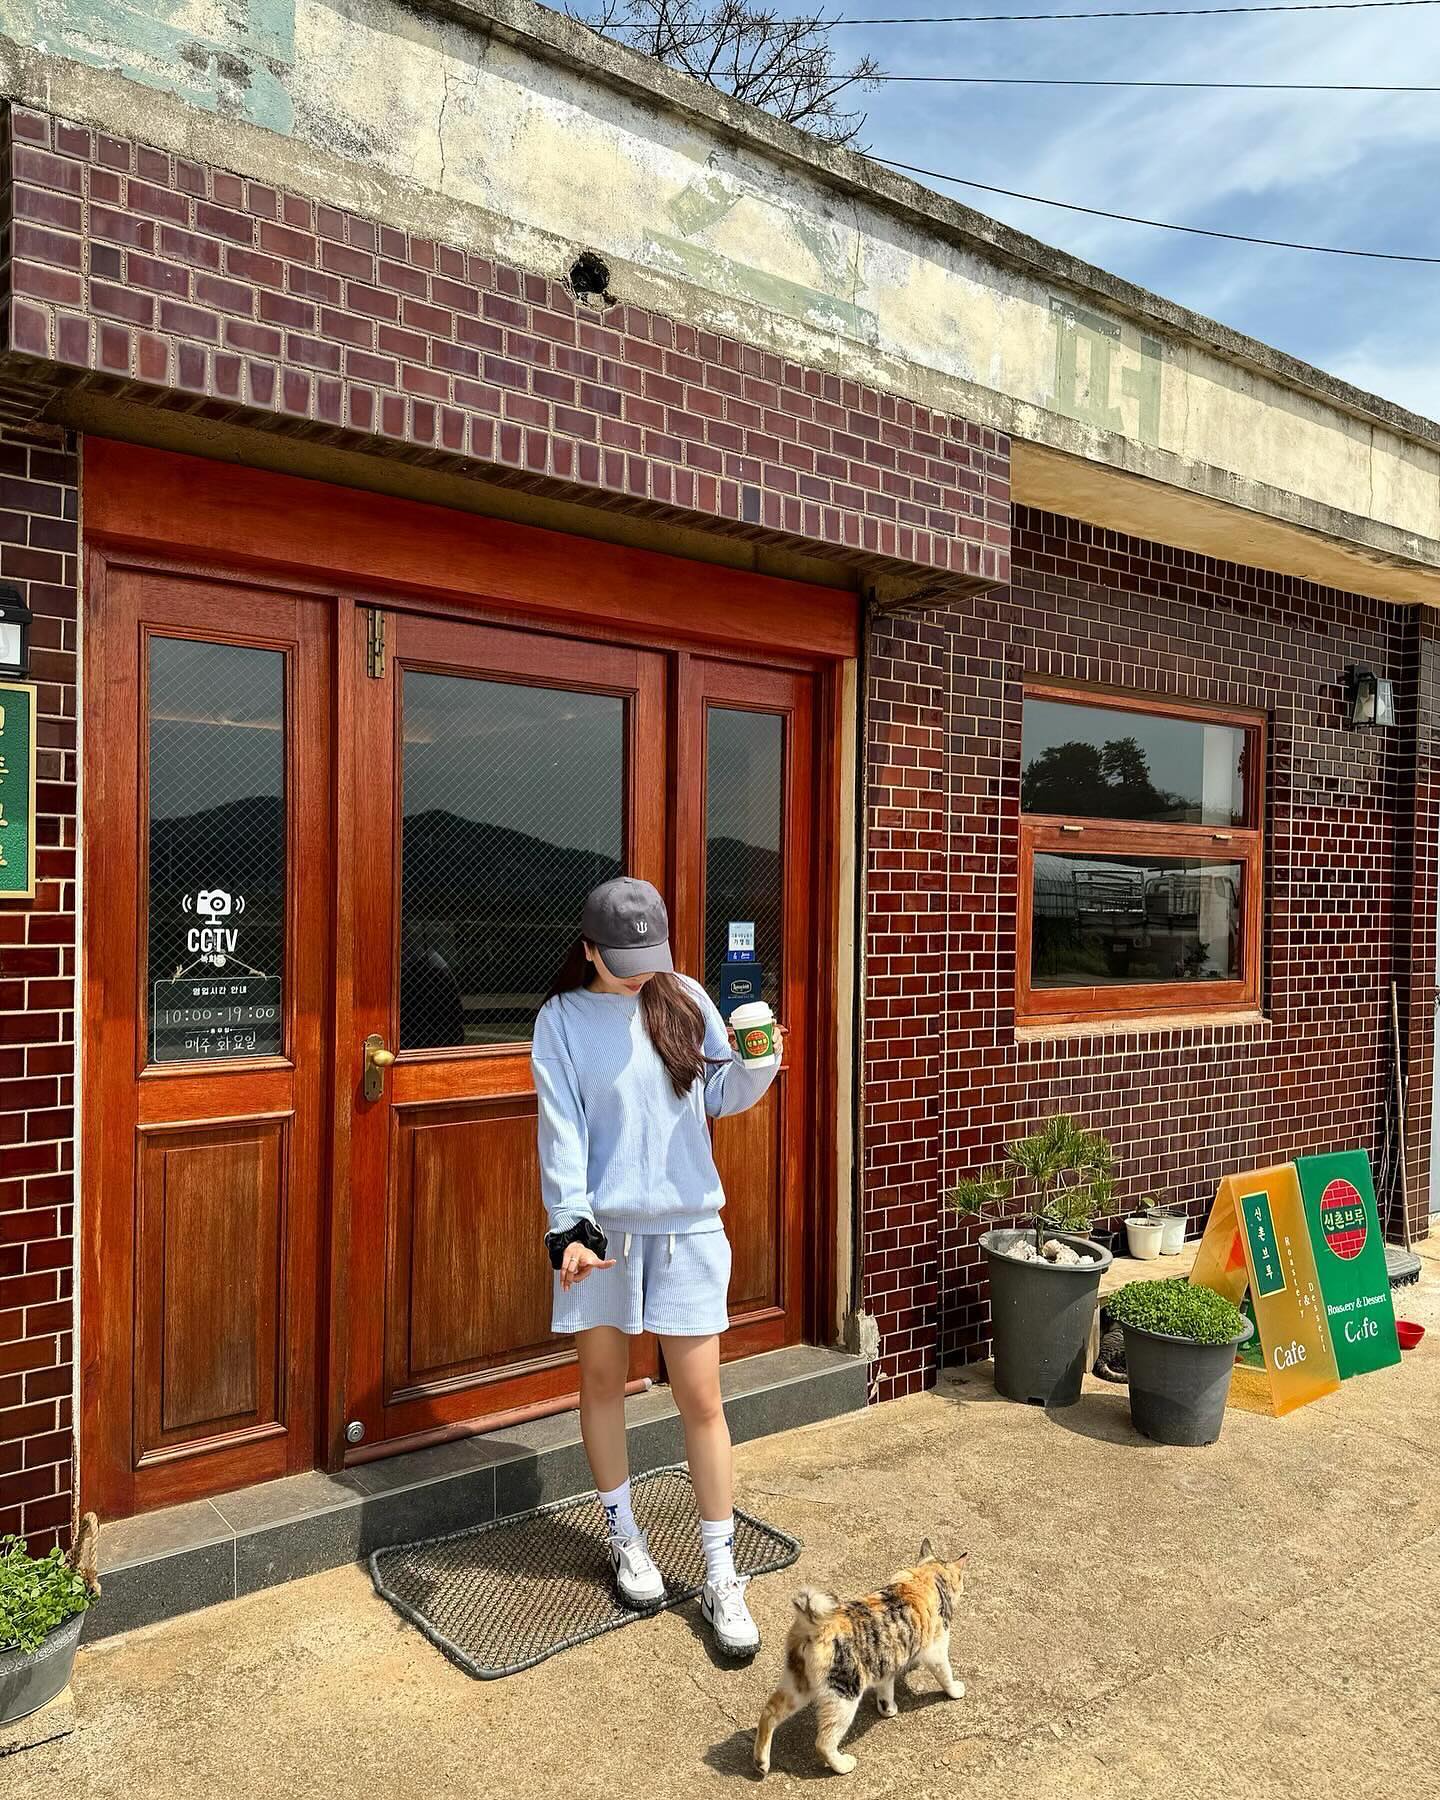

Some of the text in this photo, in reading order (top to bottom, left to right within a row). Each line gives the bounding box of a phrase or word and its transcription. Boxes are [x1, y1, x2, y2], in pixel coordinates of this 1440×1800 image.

[187, 928, 239, 953] CCTV
[192, 985, 247, 997] 영업시간 안내
[184, 1031, 257, 1054] 매주 화요일
[1324, 1208, 1365, 1231] 신촌브루
[1254, 1206, 1274, 1280] 신촌브루
[1356, 1297, 1363, 1309] &
[1362, 1292, 1387, 1307] Dessert
[1273, 1340, 1307, 1370] Cafe
